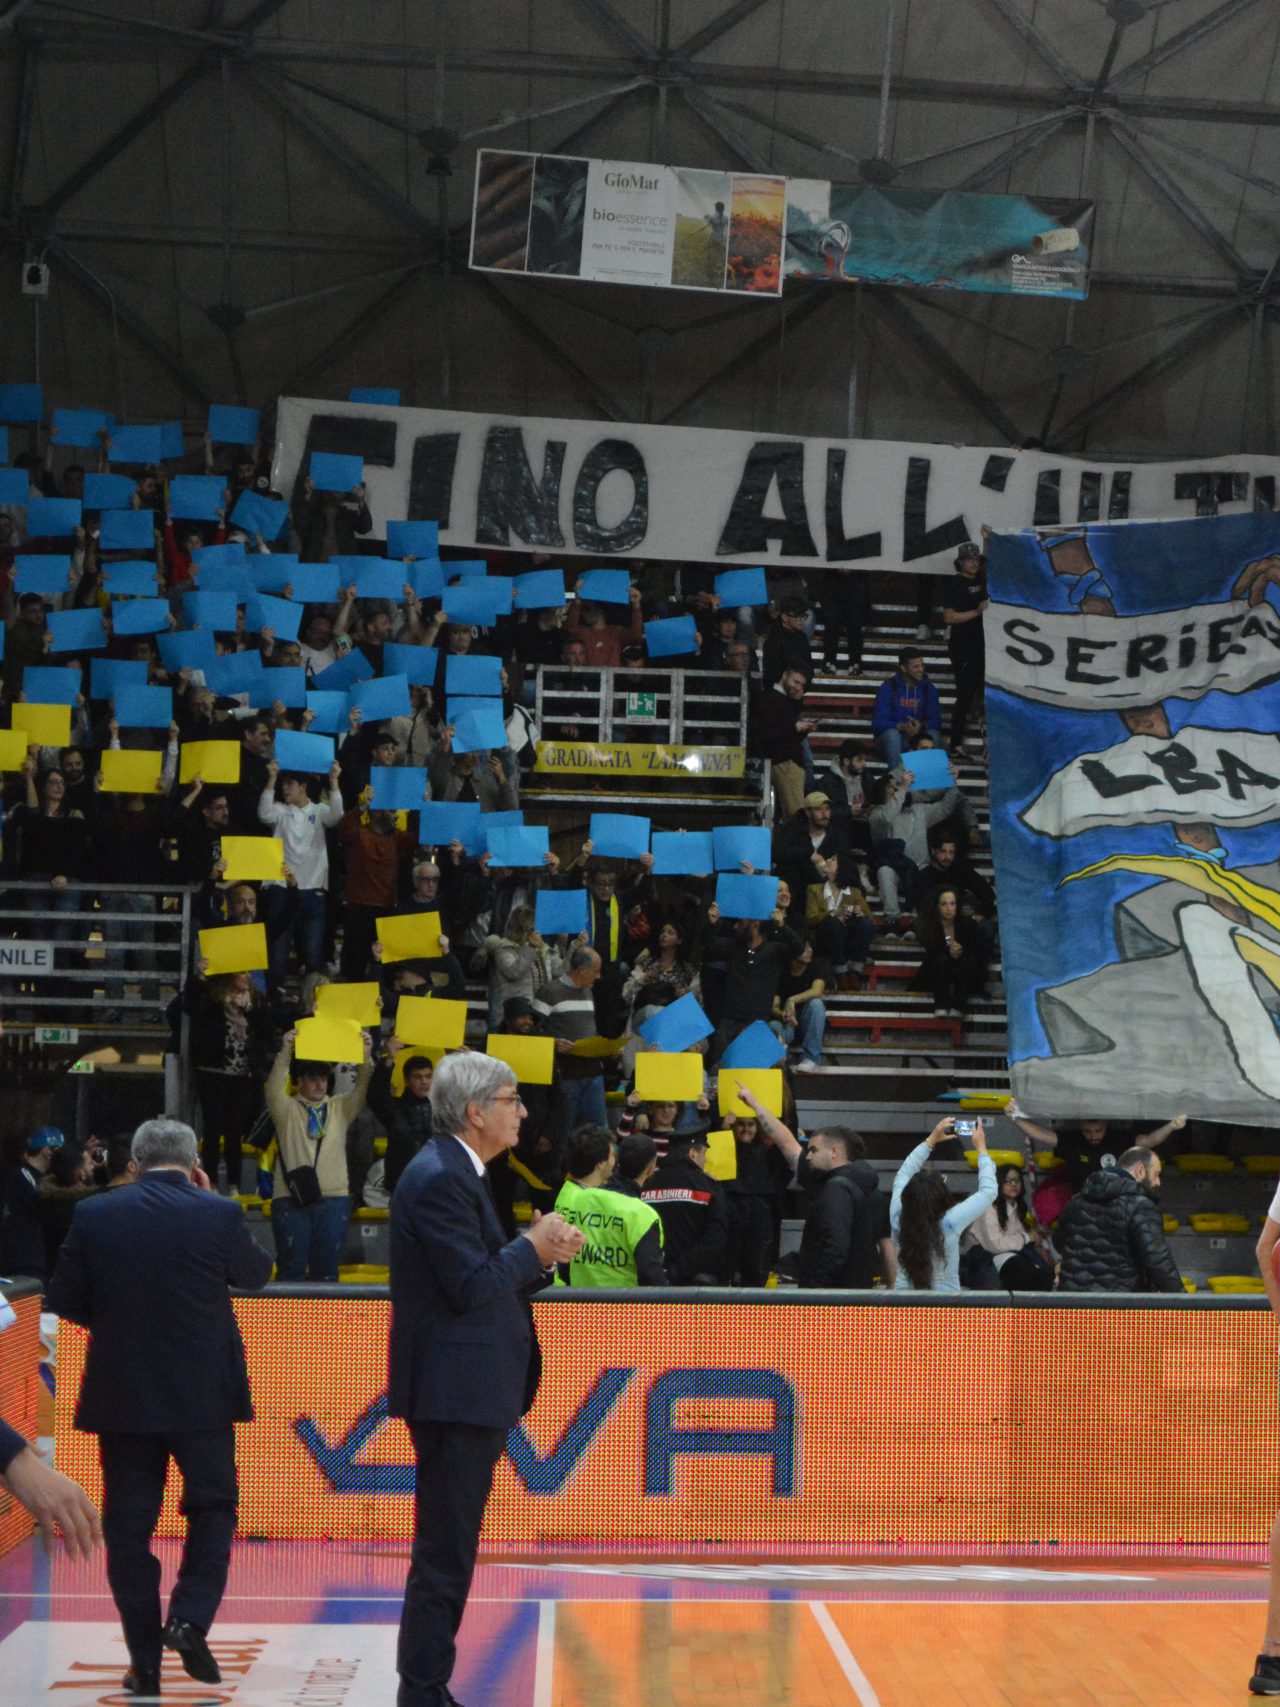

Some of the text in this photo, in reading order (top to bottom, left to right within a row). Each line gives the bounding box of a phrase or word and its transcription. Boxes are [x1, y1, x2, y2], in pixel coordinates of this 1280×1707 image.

[604, 172, 659, 190] GioMat
[592, 207, 668, 227] bioessence
[545, 749, 632, 769] GRADINATA
[640, 1189, 693, 1201] CARABINIERI
[574, 1243, 629, 1268] WARD
